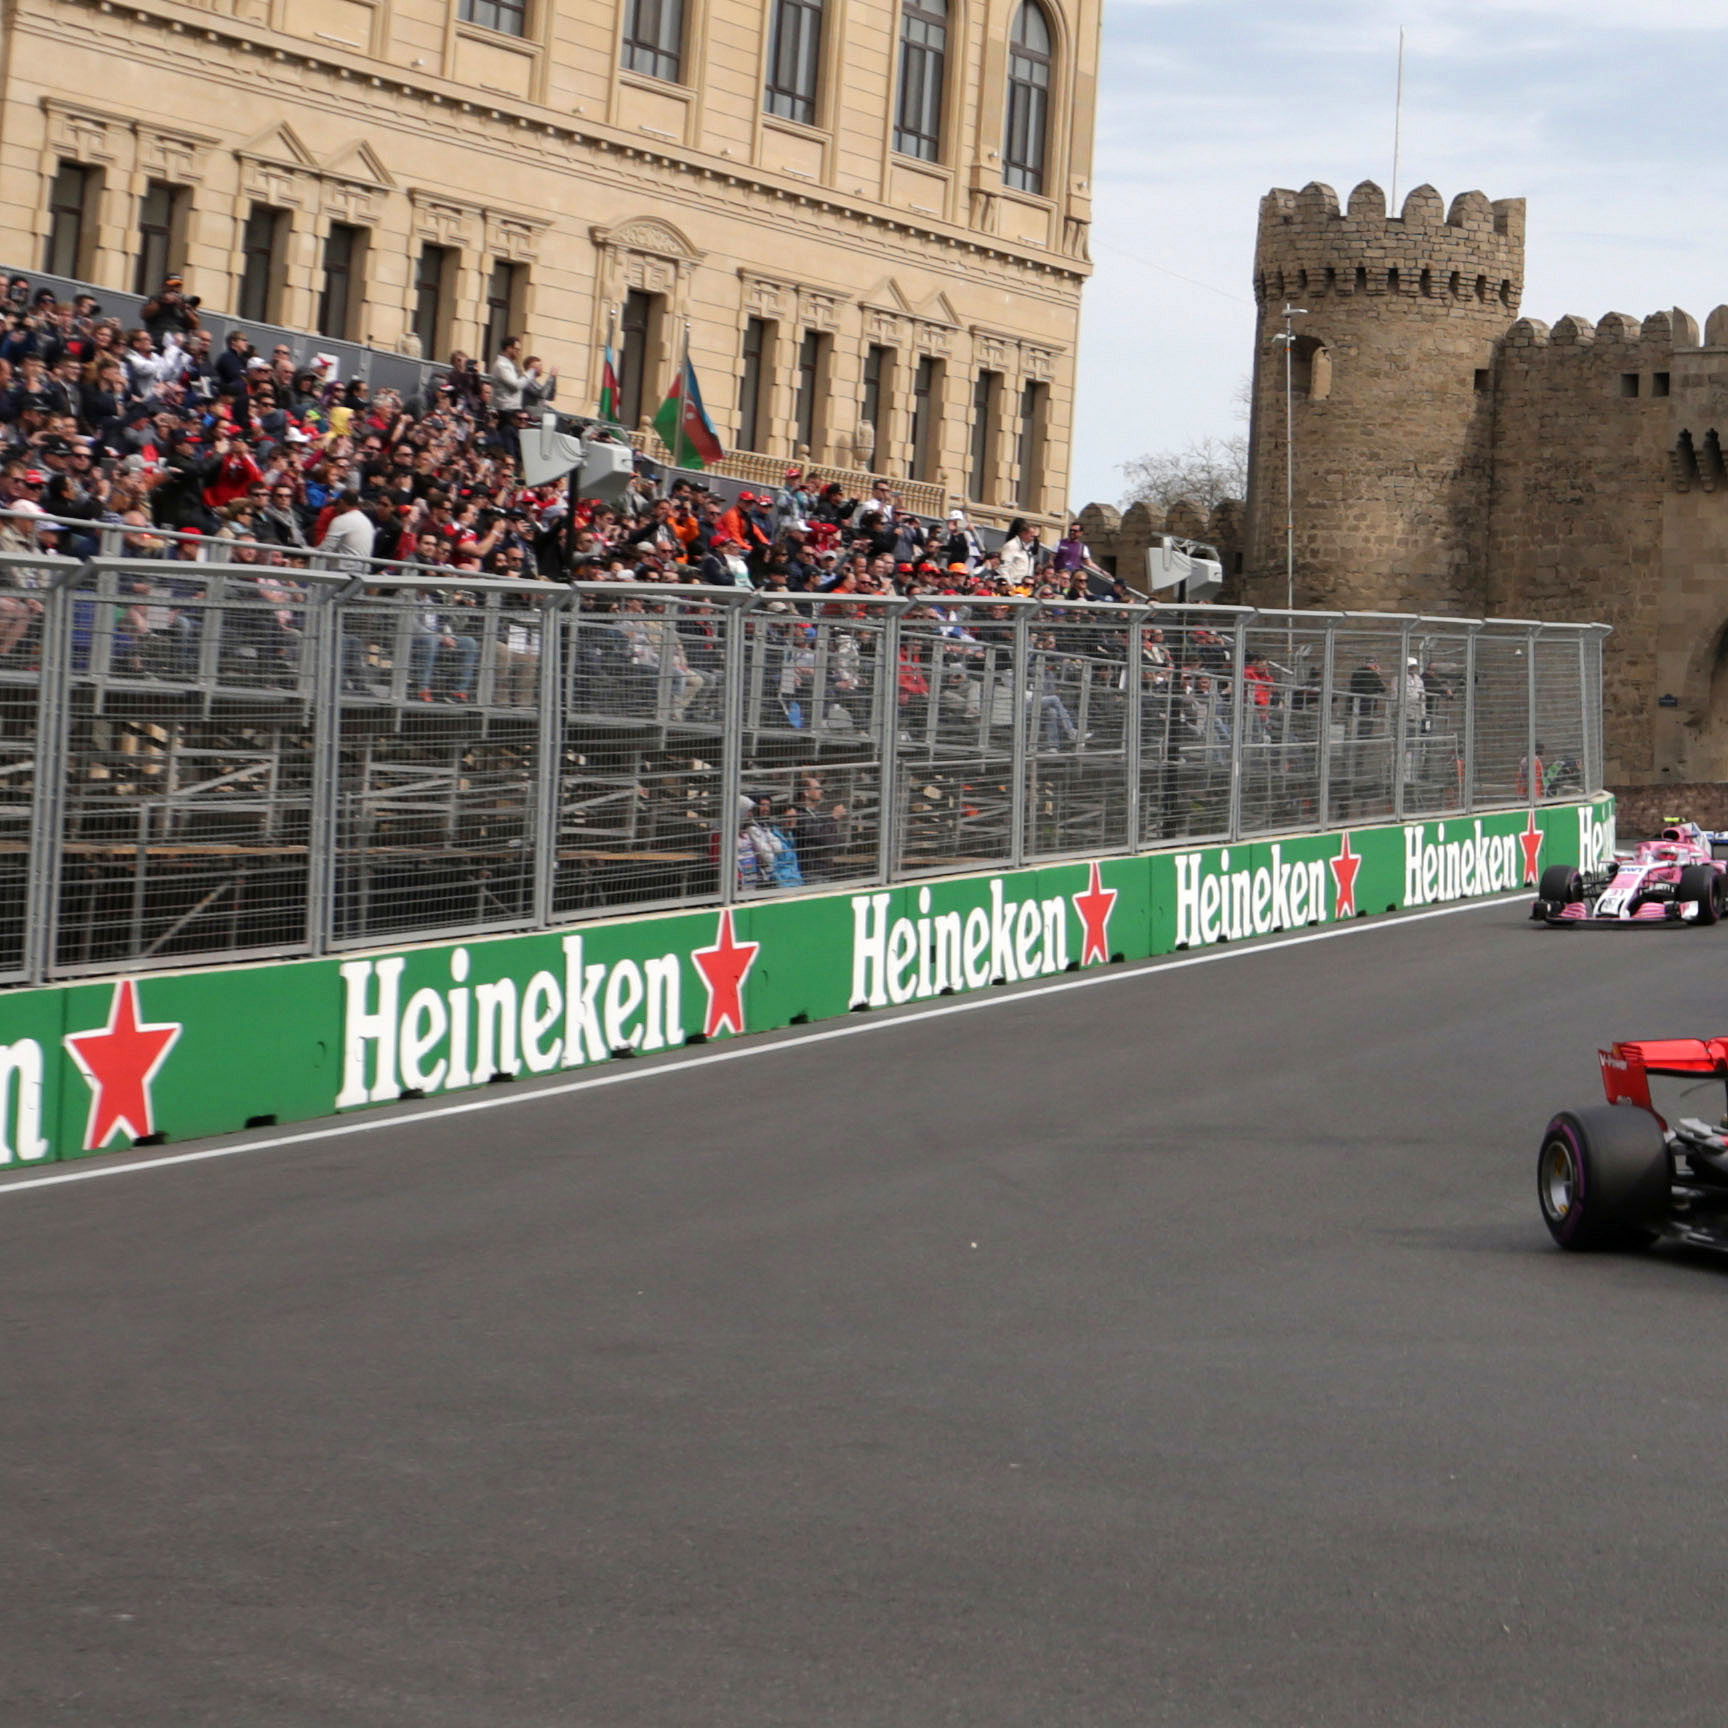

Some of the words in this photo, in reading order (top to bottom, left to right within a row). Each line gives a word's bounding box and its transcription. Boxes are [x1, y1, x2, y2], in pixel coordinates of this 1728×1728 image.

[1174, 843, 1327, 947] Heineken
[1403, 819, 1518, 906] Heineken
[849, 878, 1069, 1011] Heineken
[334, 935, 685, 1108] Heineken
